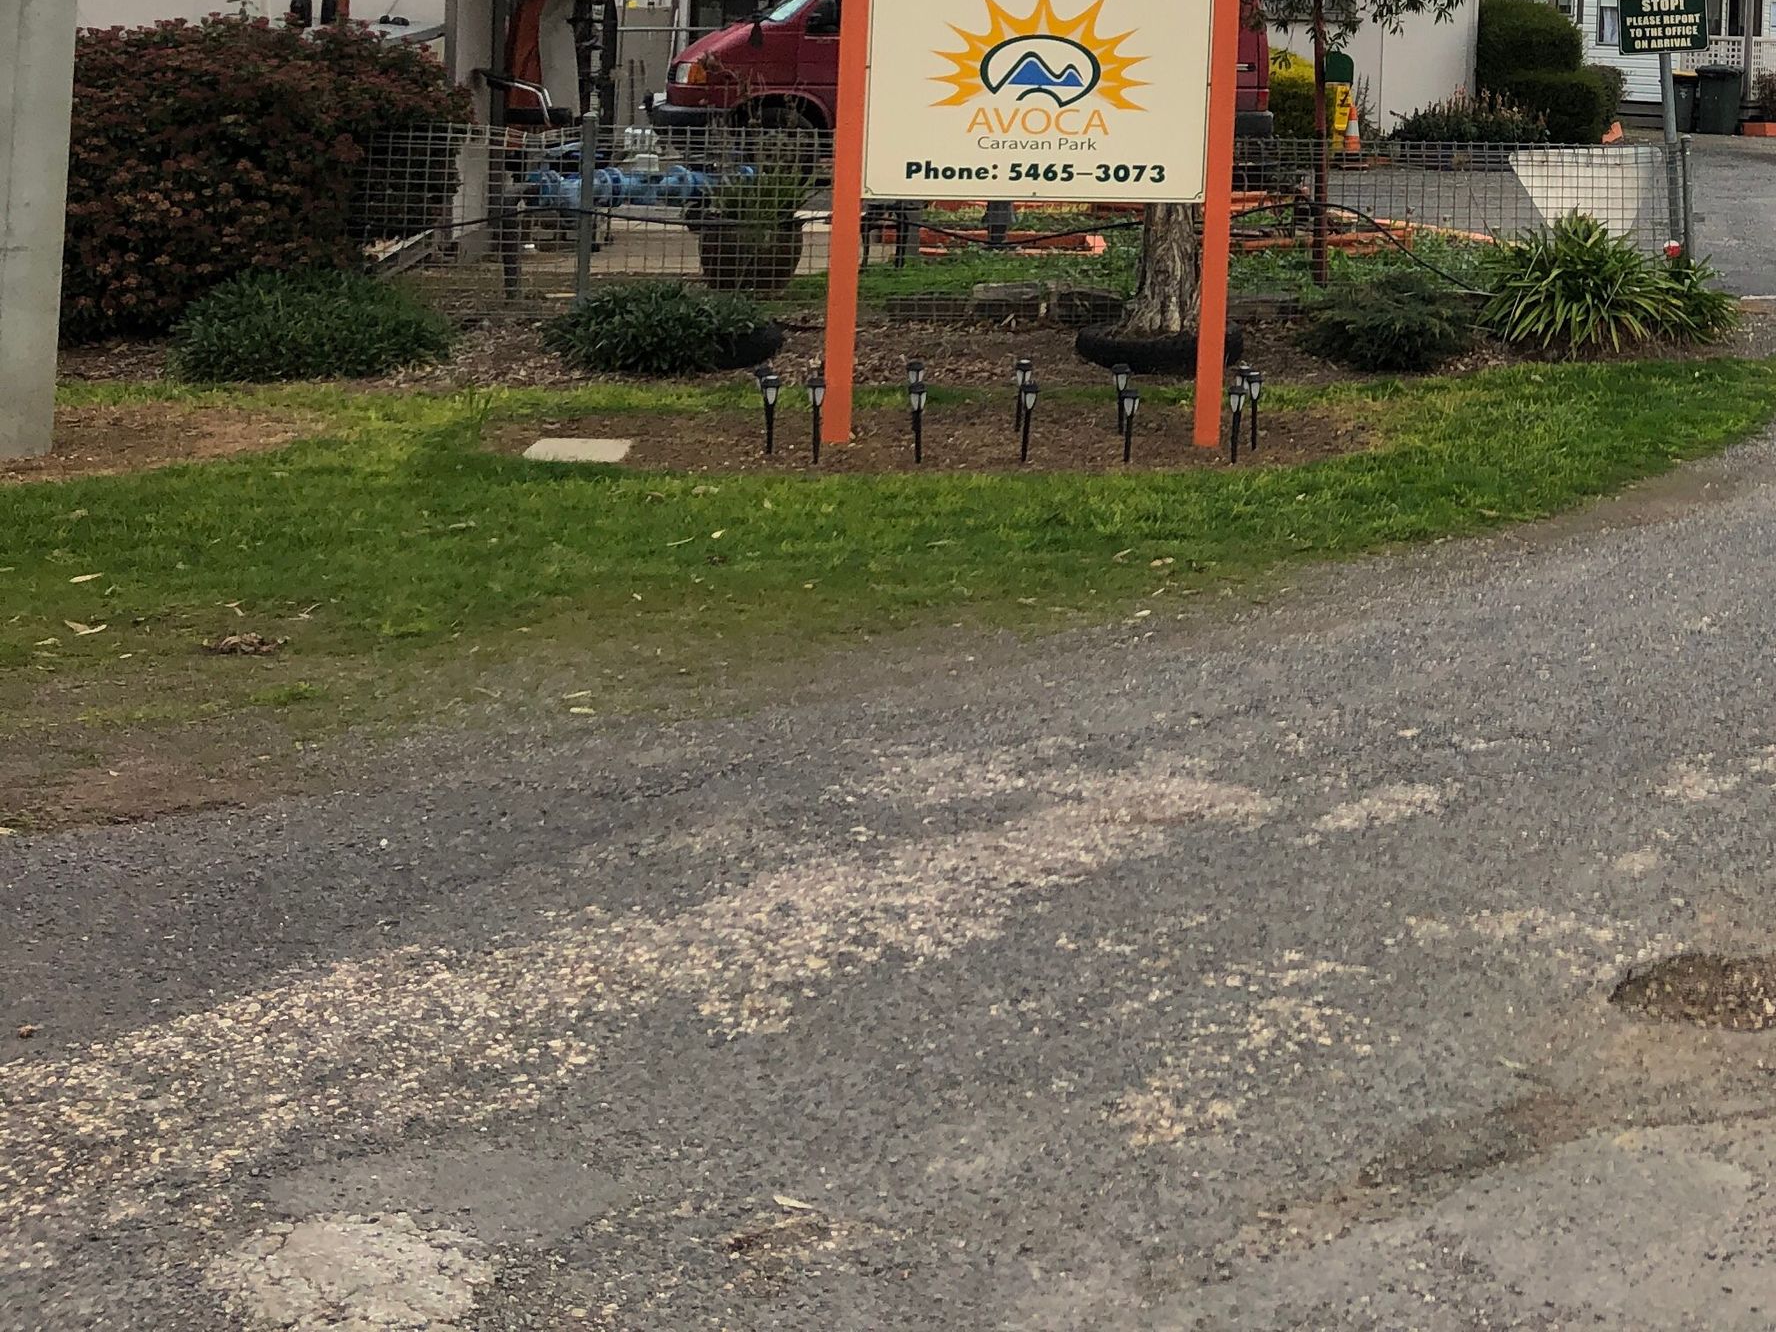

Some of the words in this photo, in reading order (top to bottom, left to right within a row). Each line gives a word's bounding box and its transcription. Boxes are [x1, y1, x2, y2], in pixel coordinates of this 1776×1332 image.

[1626, 15, 1661, 26] PLEASE
[1663, 13, 1700, 24] REPORT
[1629, 28, 1643, 38] TO
[1644, 27, 1663, 37] THE
[1665, 25, 1698, 36] OFFICE
[1634, 39, 1648, 49] ON
[1650, 37, 1692, 49] ARRIVAL
[966, 107, 1110, 136] AVOCA
[977, 136, 1052, 151] Caravan
[1058, 137, 1097, 152] Park
[905, 161, 999, 181] Phone:
